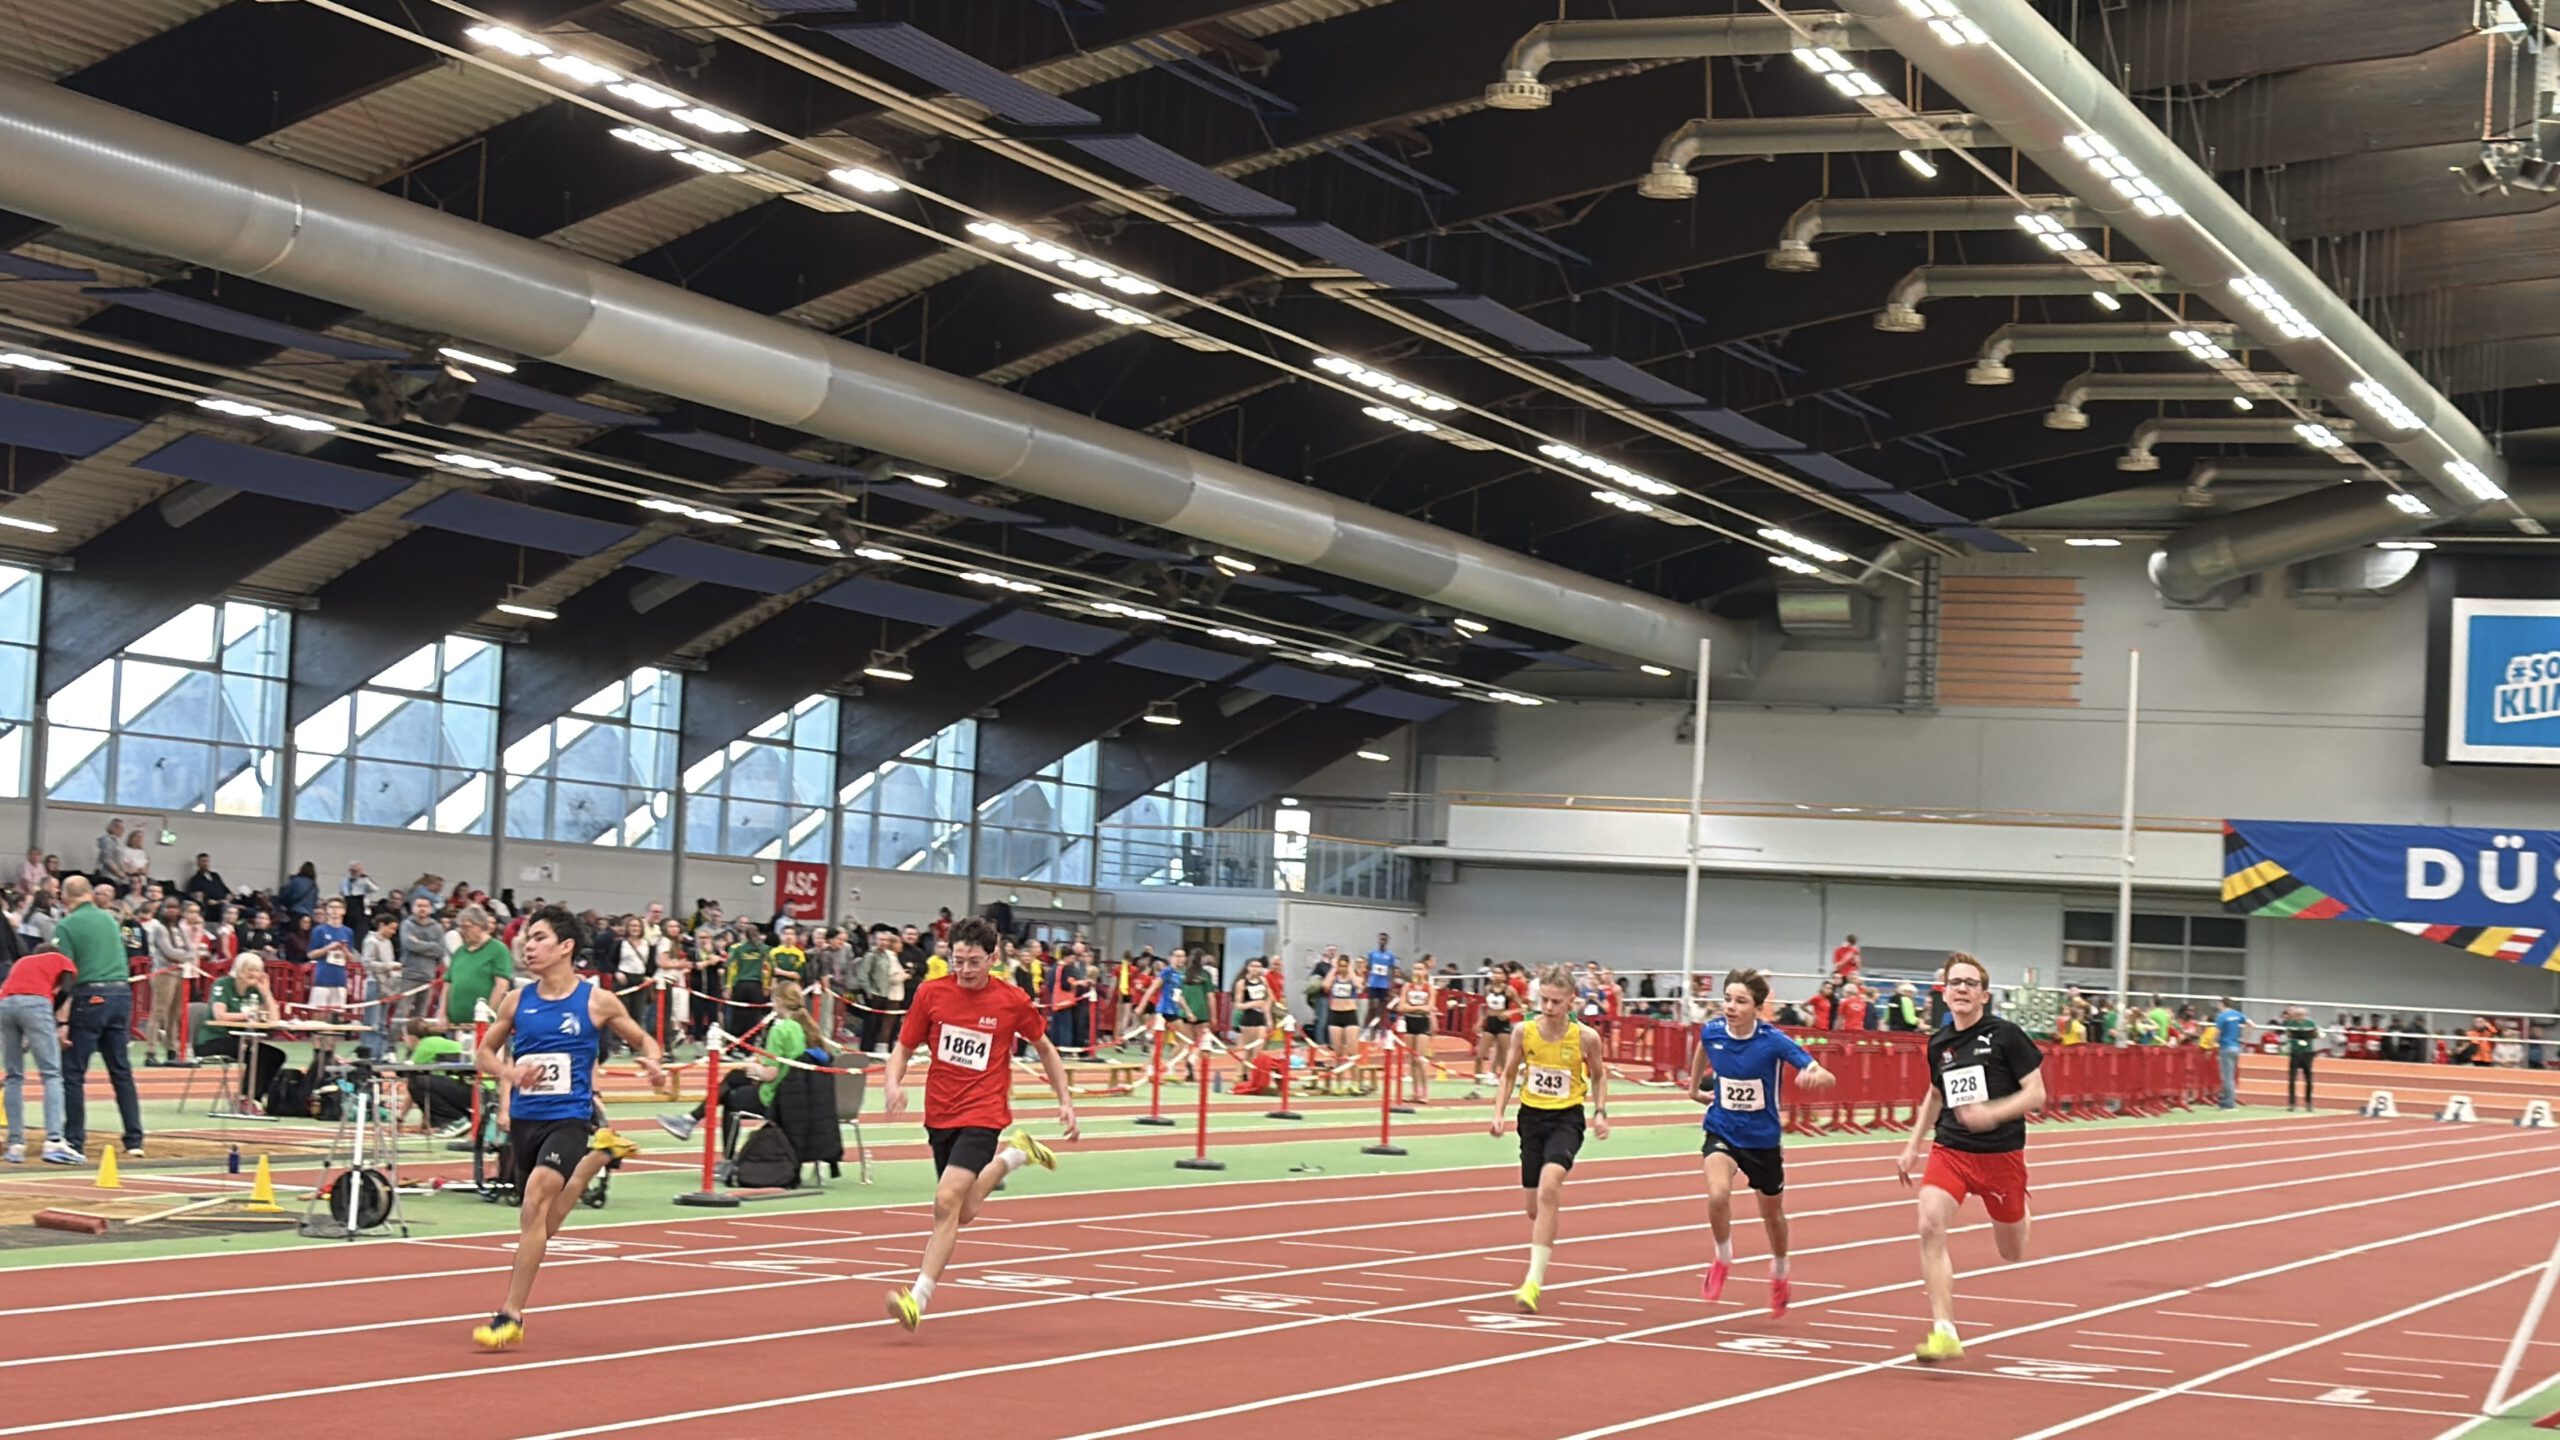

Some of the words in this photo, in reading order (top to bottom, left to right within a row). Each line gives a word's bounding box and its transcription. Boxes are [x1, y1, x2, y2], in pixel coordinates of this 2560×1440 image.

[2406, 834, 2560, 904] DÜ
[783, 870, 819, 897] ASC
[943, 1034, 987, 1058] 1864
[535, 1064, 560, 1082] 23
[1534, 1073, 1563, 1089] 243
[1726, 1086, 1756, 1102] 222
[1950, 1076, 1977, 1096] 228
